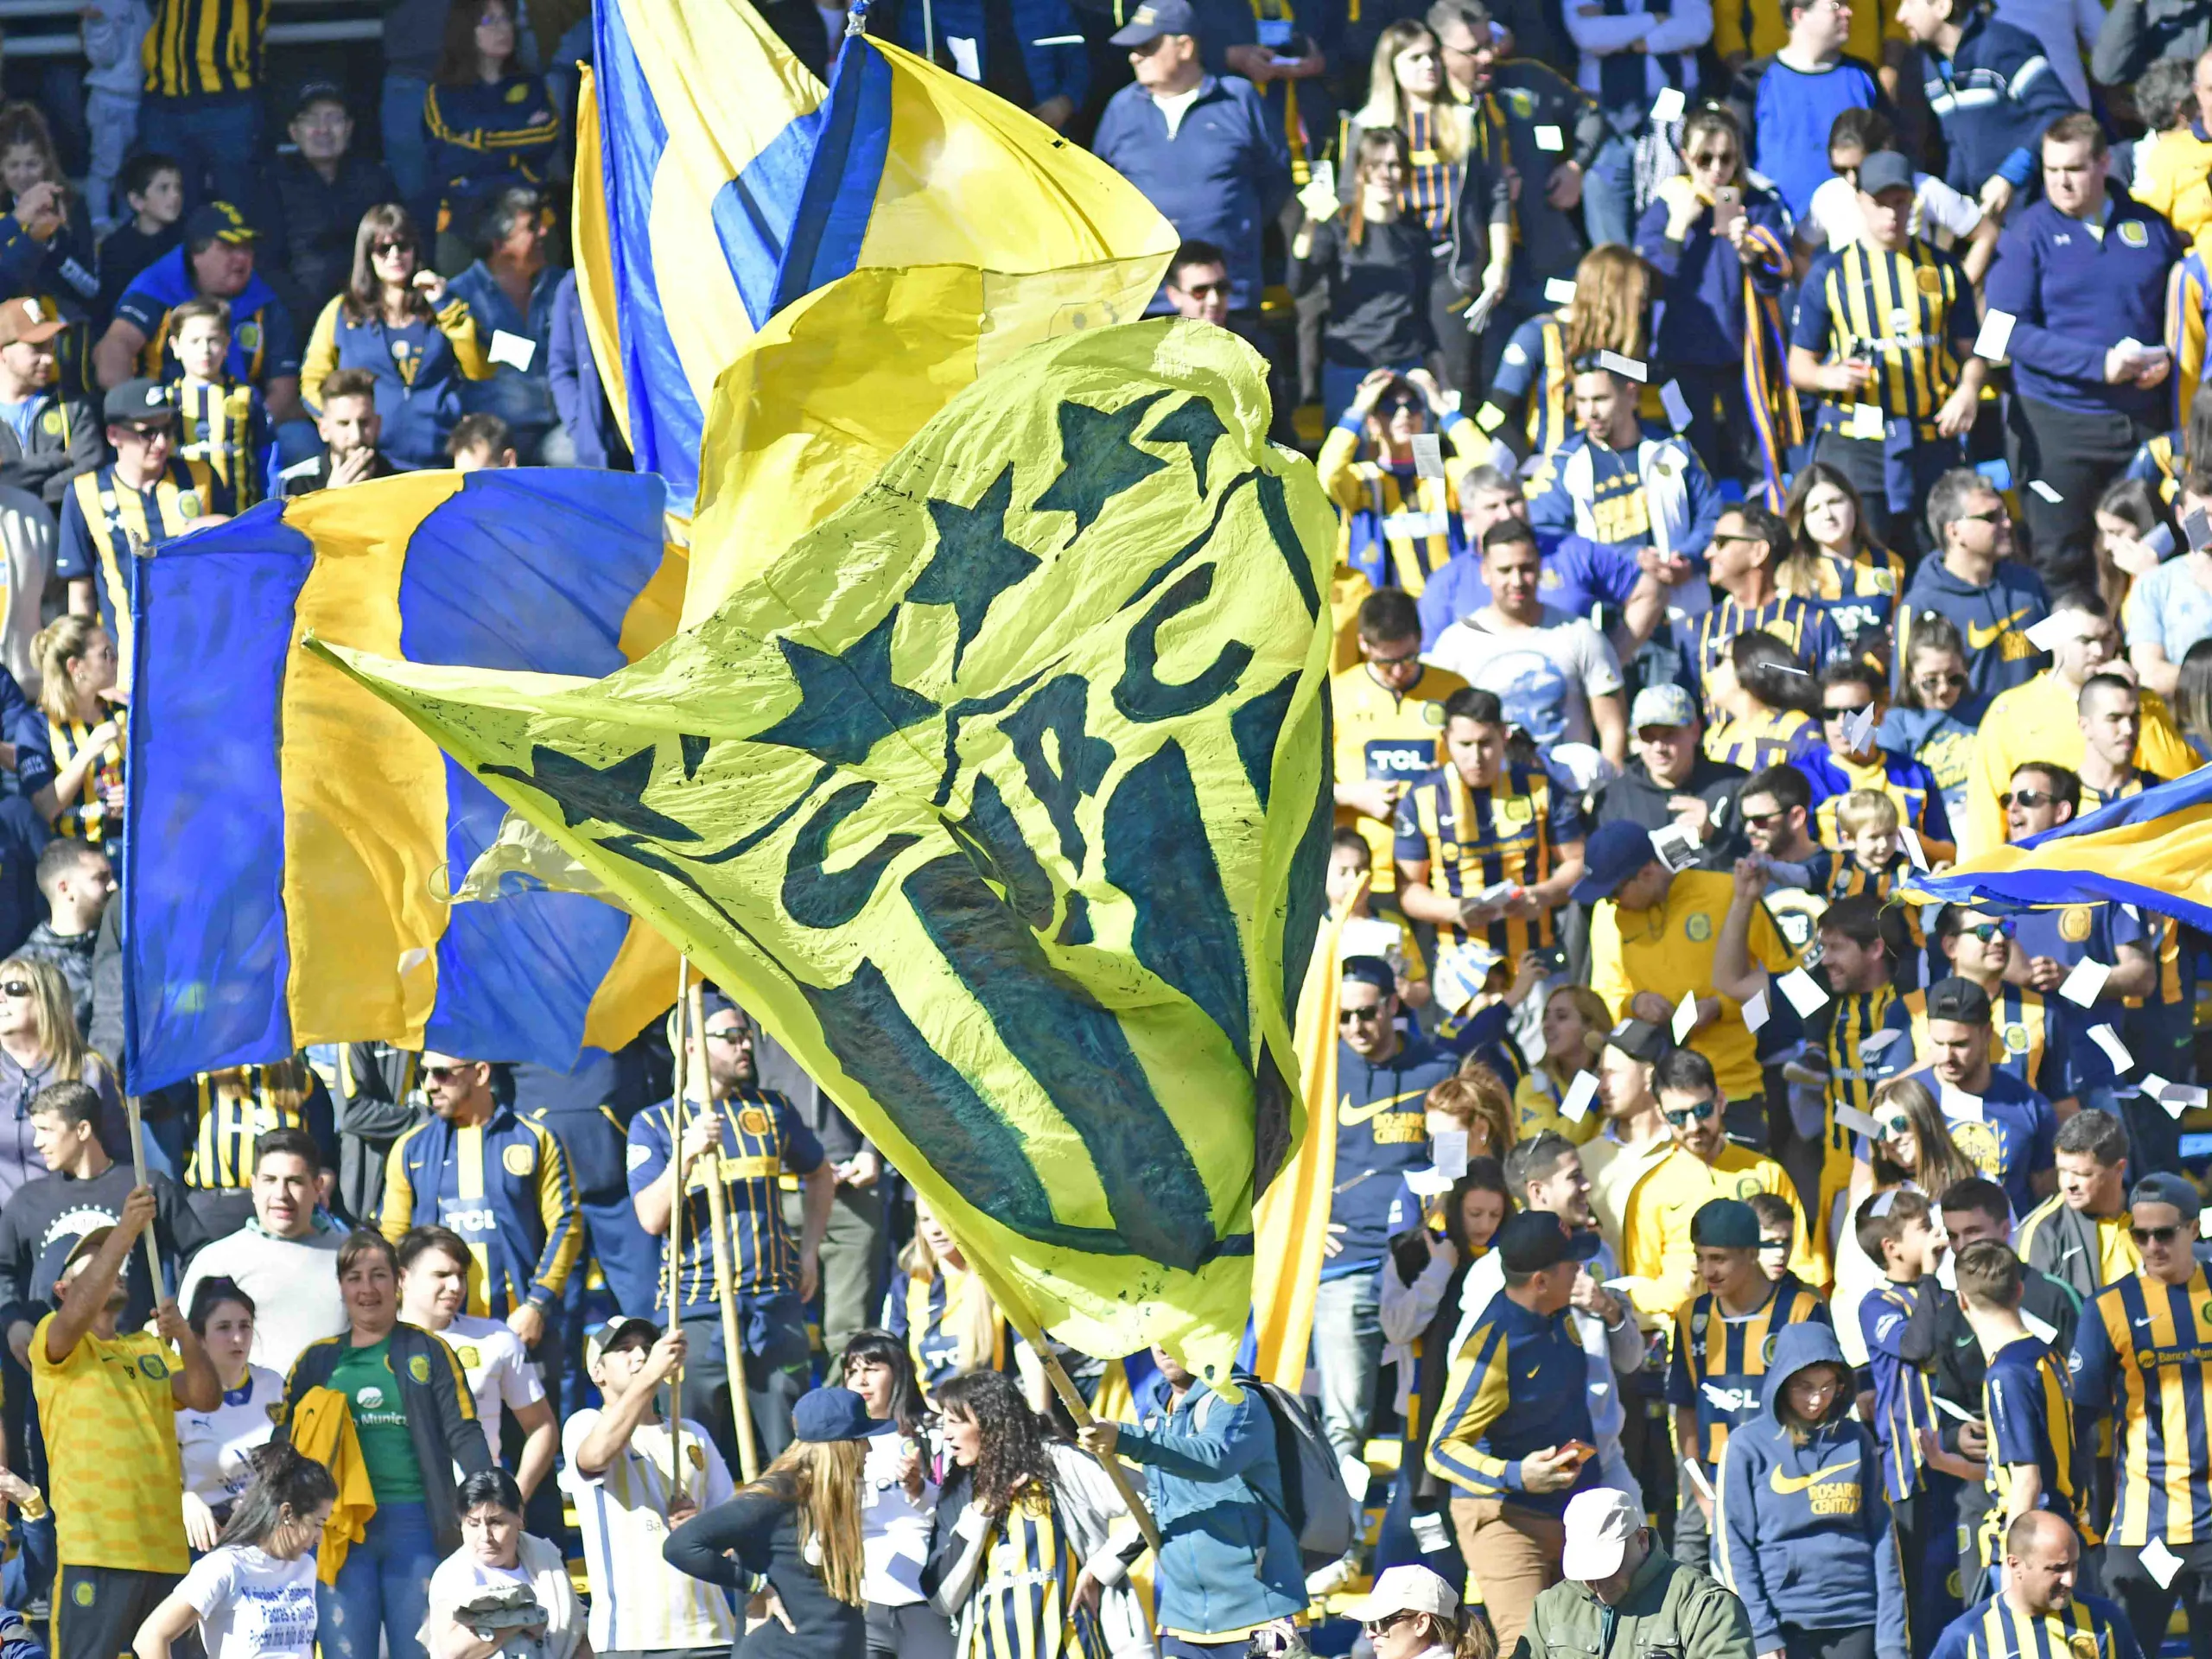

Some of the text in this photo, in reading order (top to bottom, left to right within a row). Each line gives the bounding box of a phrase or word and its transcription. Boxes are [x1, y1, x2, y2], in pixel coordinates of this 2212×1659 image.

[1370, 749, 1428, 772] TCL
[444, 1209, 498, 1233] TCL
[1713, 1388, 1761, 1409] CL
